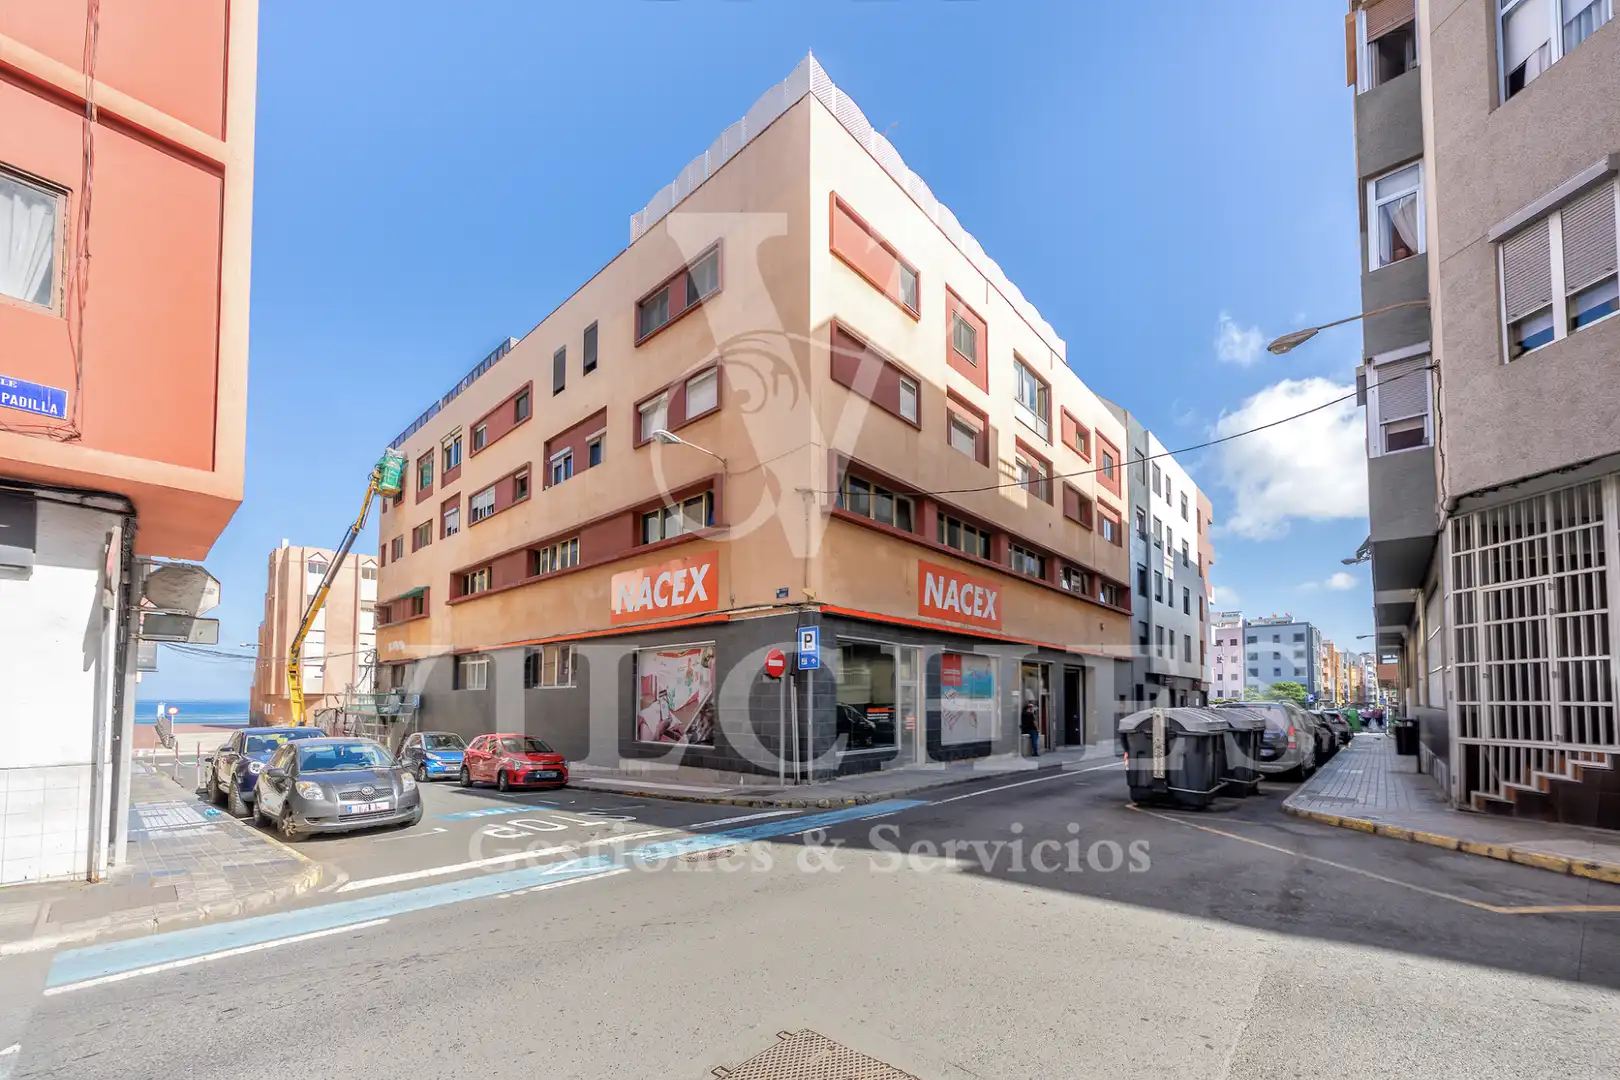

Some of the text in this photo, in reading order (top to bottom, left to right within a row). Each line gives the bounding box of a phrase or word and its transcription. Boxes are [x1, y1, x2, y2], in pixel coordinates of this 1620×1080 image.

[2, 392, 57, 414] PADILLA
[615, 563, 711, 615] NACEX
[924, 571, 998, 620] NACEX
